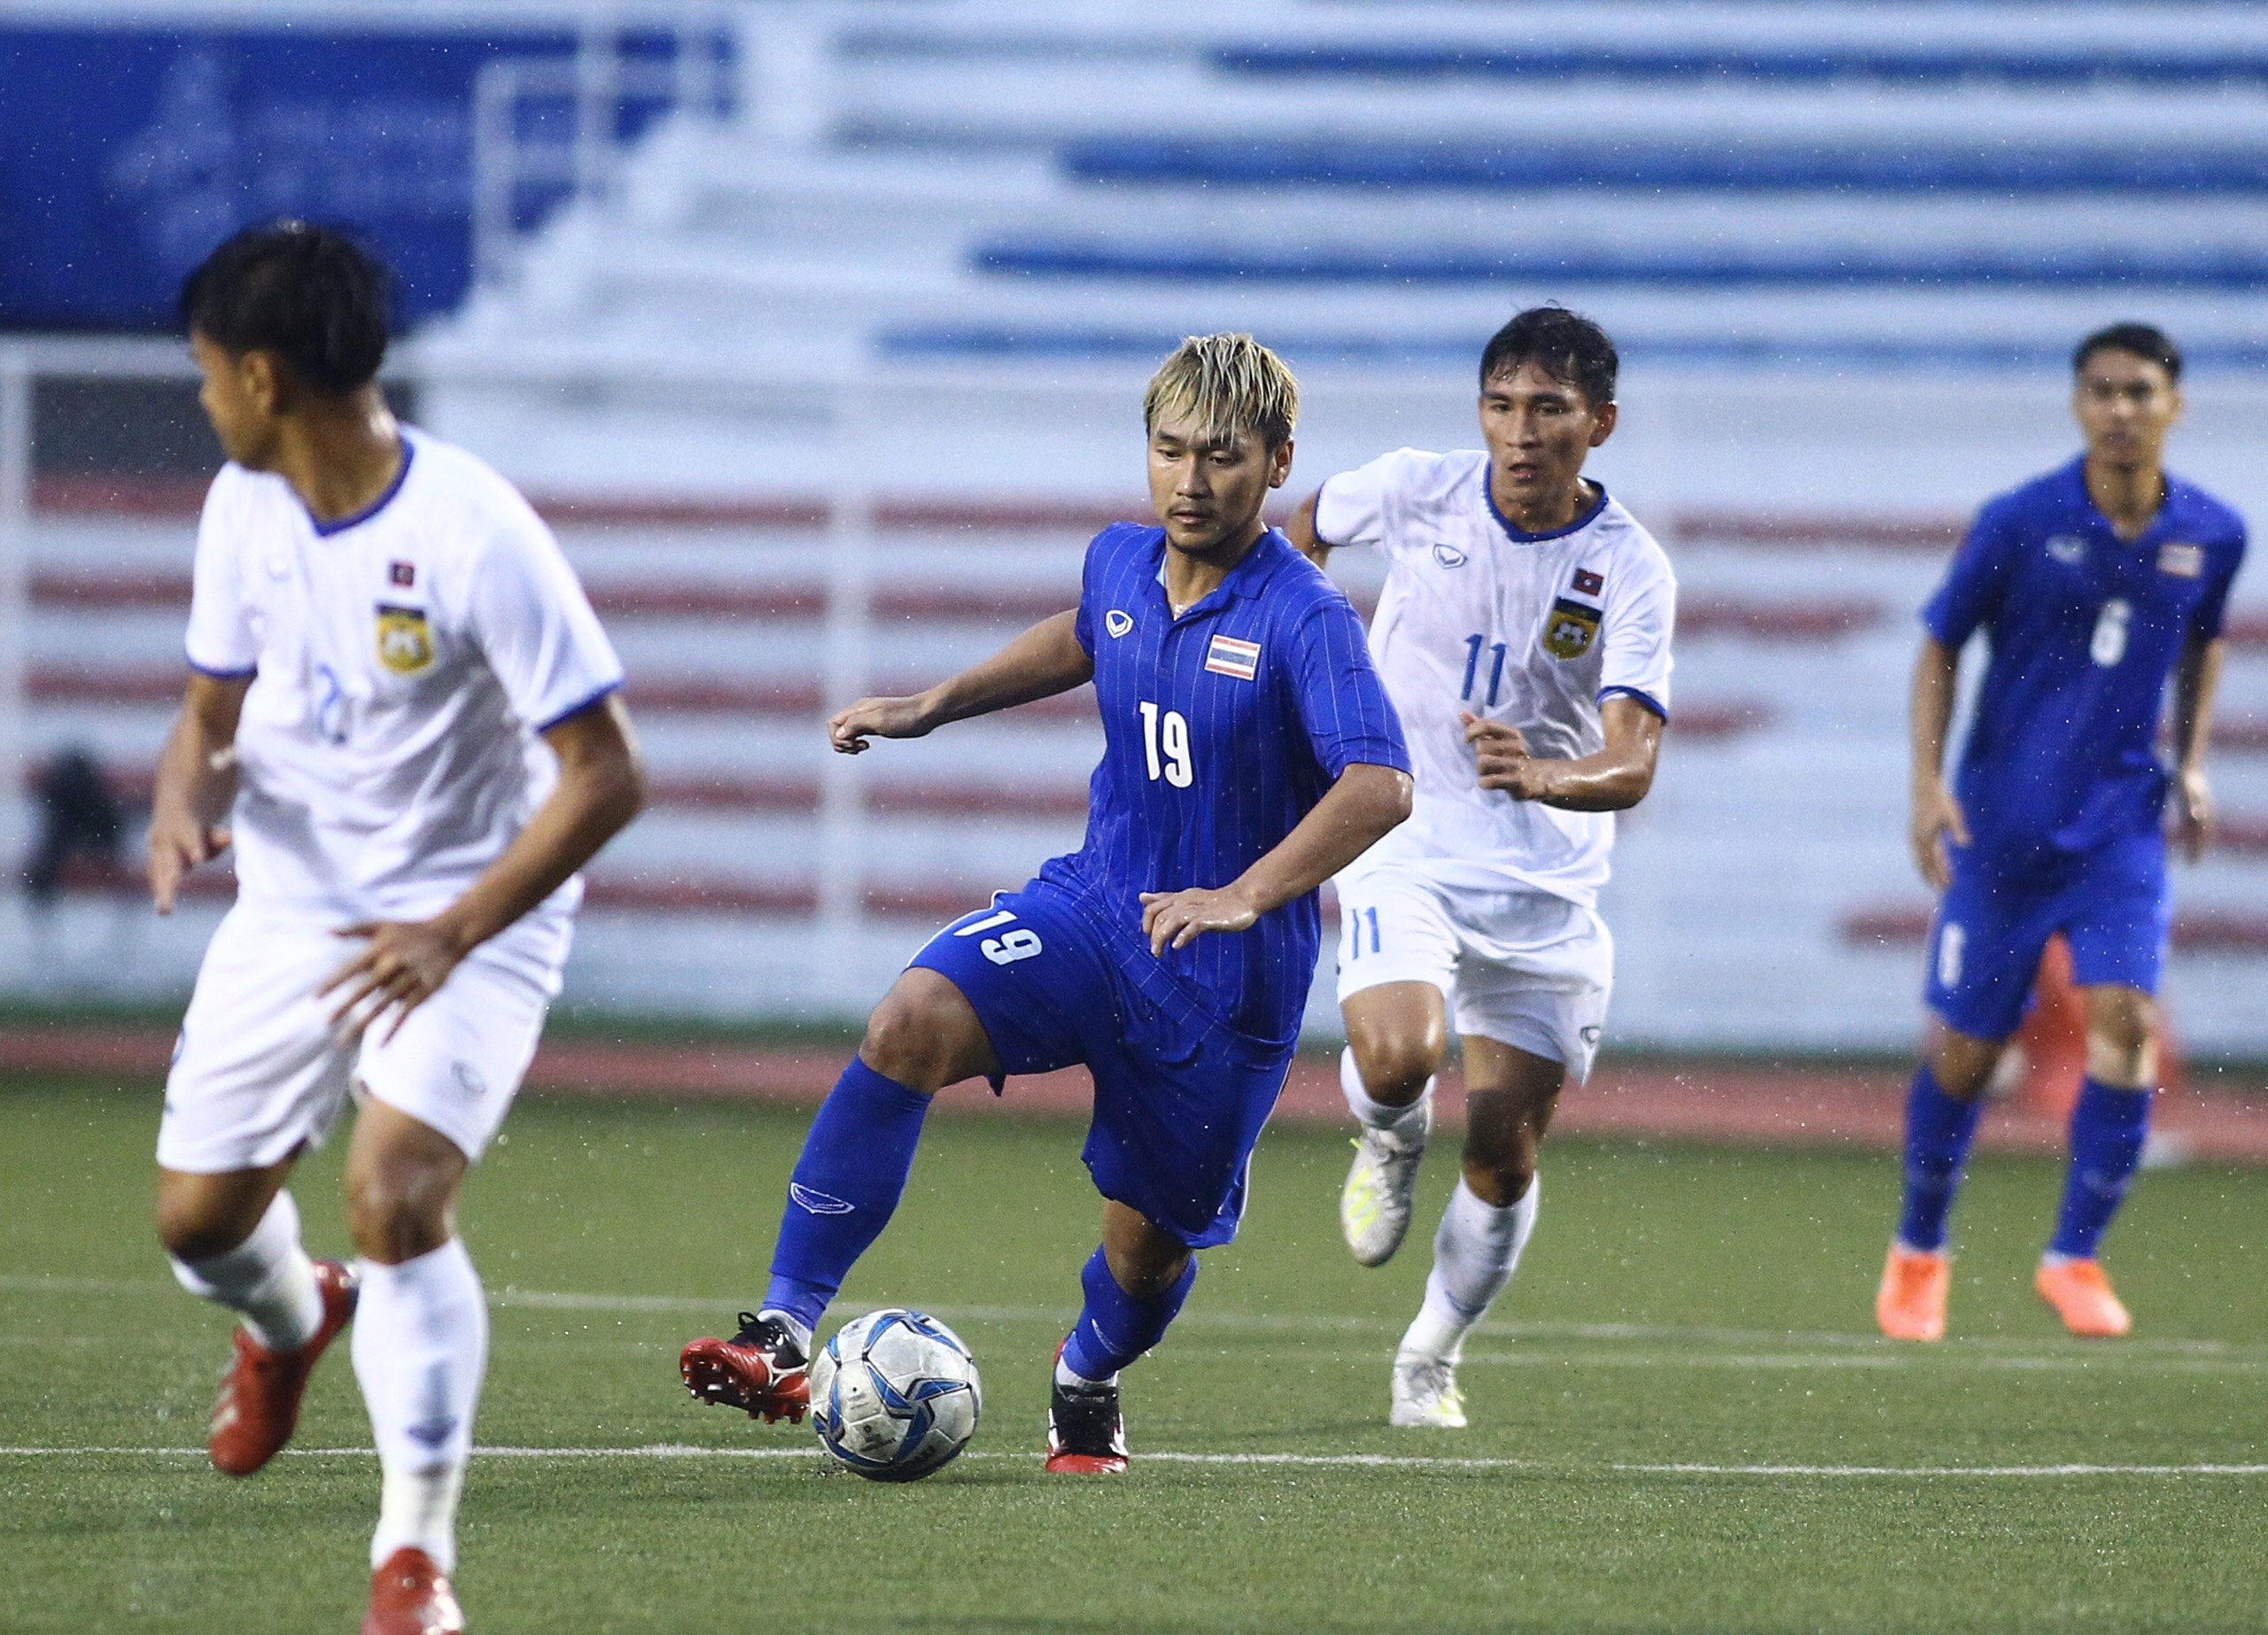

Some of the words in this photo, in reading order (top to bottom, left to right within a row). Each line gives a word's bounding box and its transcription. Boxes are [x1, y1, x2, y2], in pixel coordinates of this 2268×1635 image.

[1460, 632, 1508, 708] 11
[1139, 701, 1194, 789] 19
[952, 910, 1044, 966] 19
[1351, 906, 1380, 961] 11
